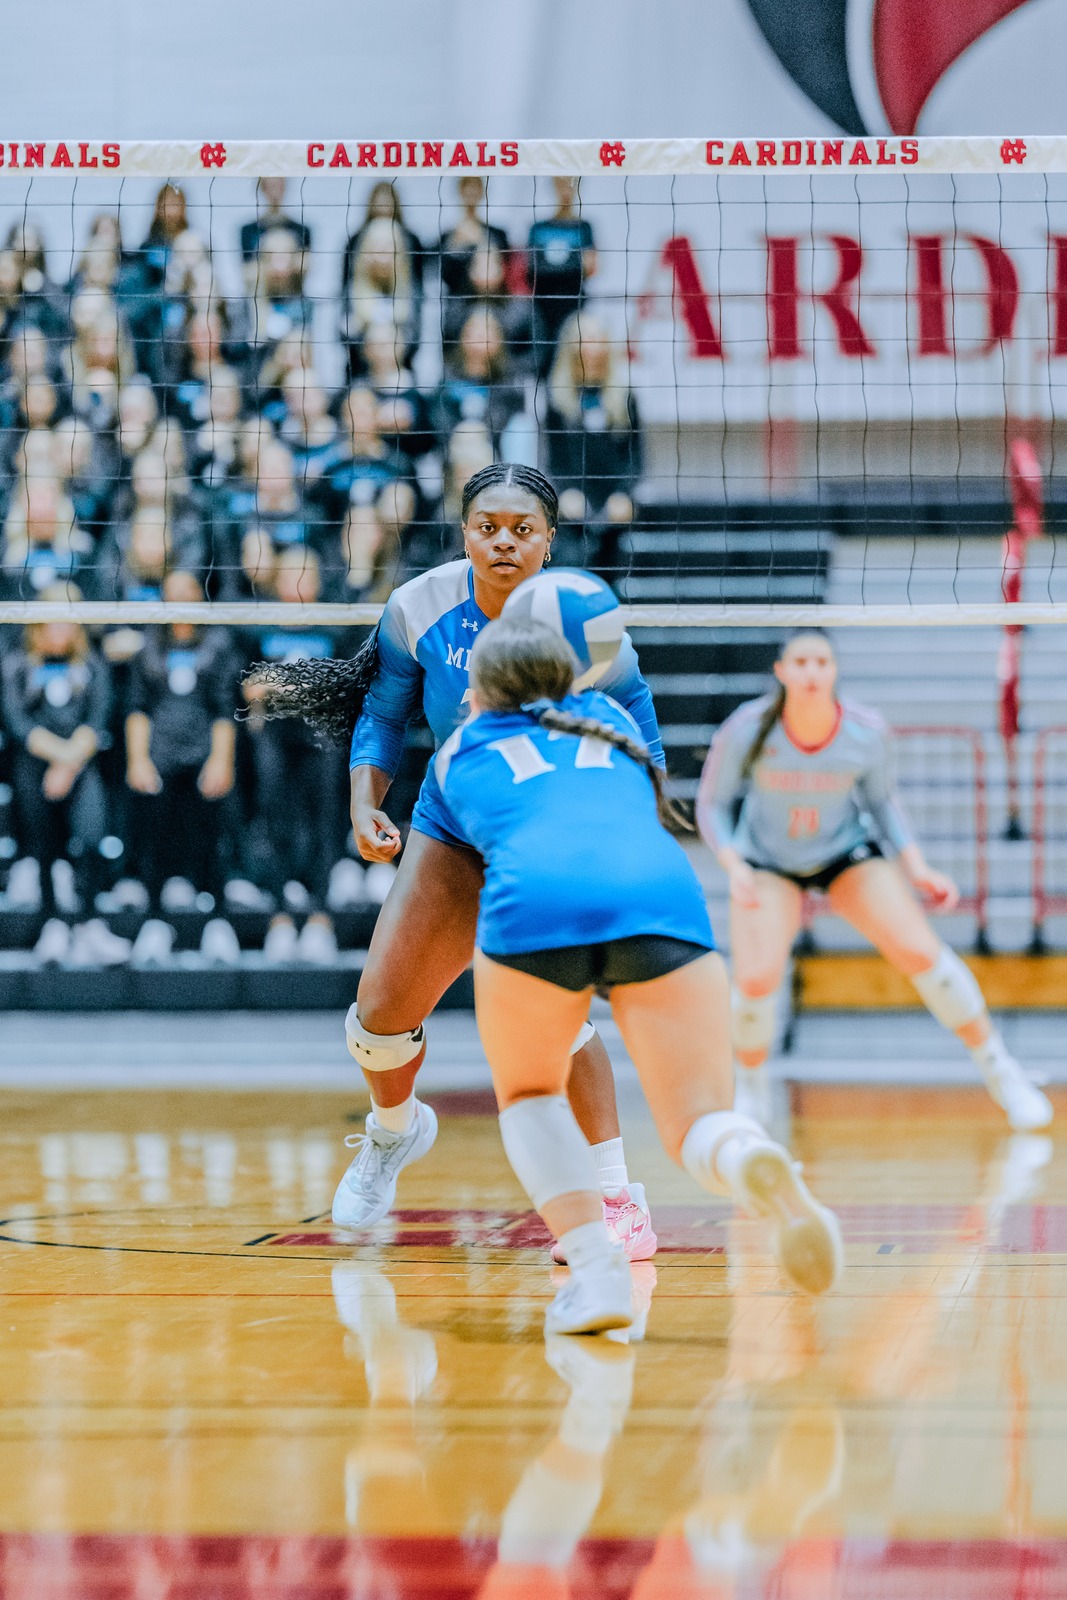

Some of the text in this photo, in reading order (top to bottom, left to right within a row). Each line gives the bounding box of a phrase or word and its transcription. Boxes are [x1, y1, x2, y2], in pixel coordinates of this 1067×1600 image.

[0, 142, 120, 168] INALS
[307, 141, 520, 168] CARDINALS
[706, 139, 919, 166] CARDINALS
[505, 235, 1067, 361] ARD
